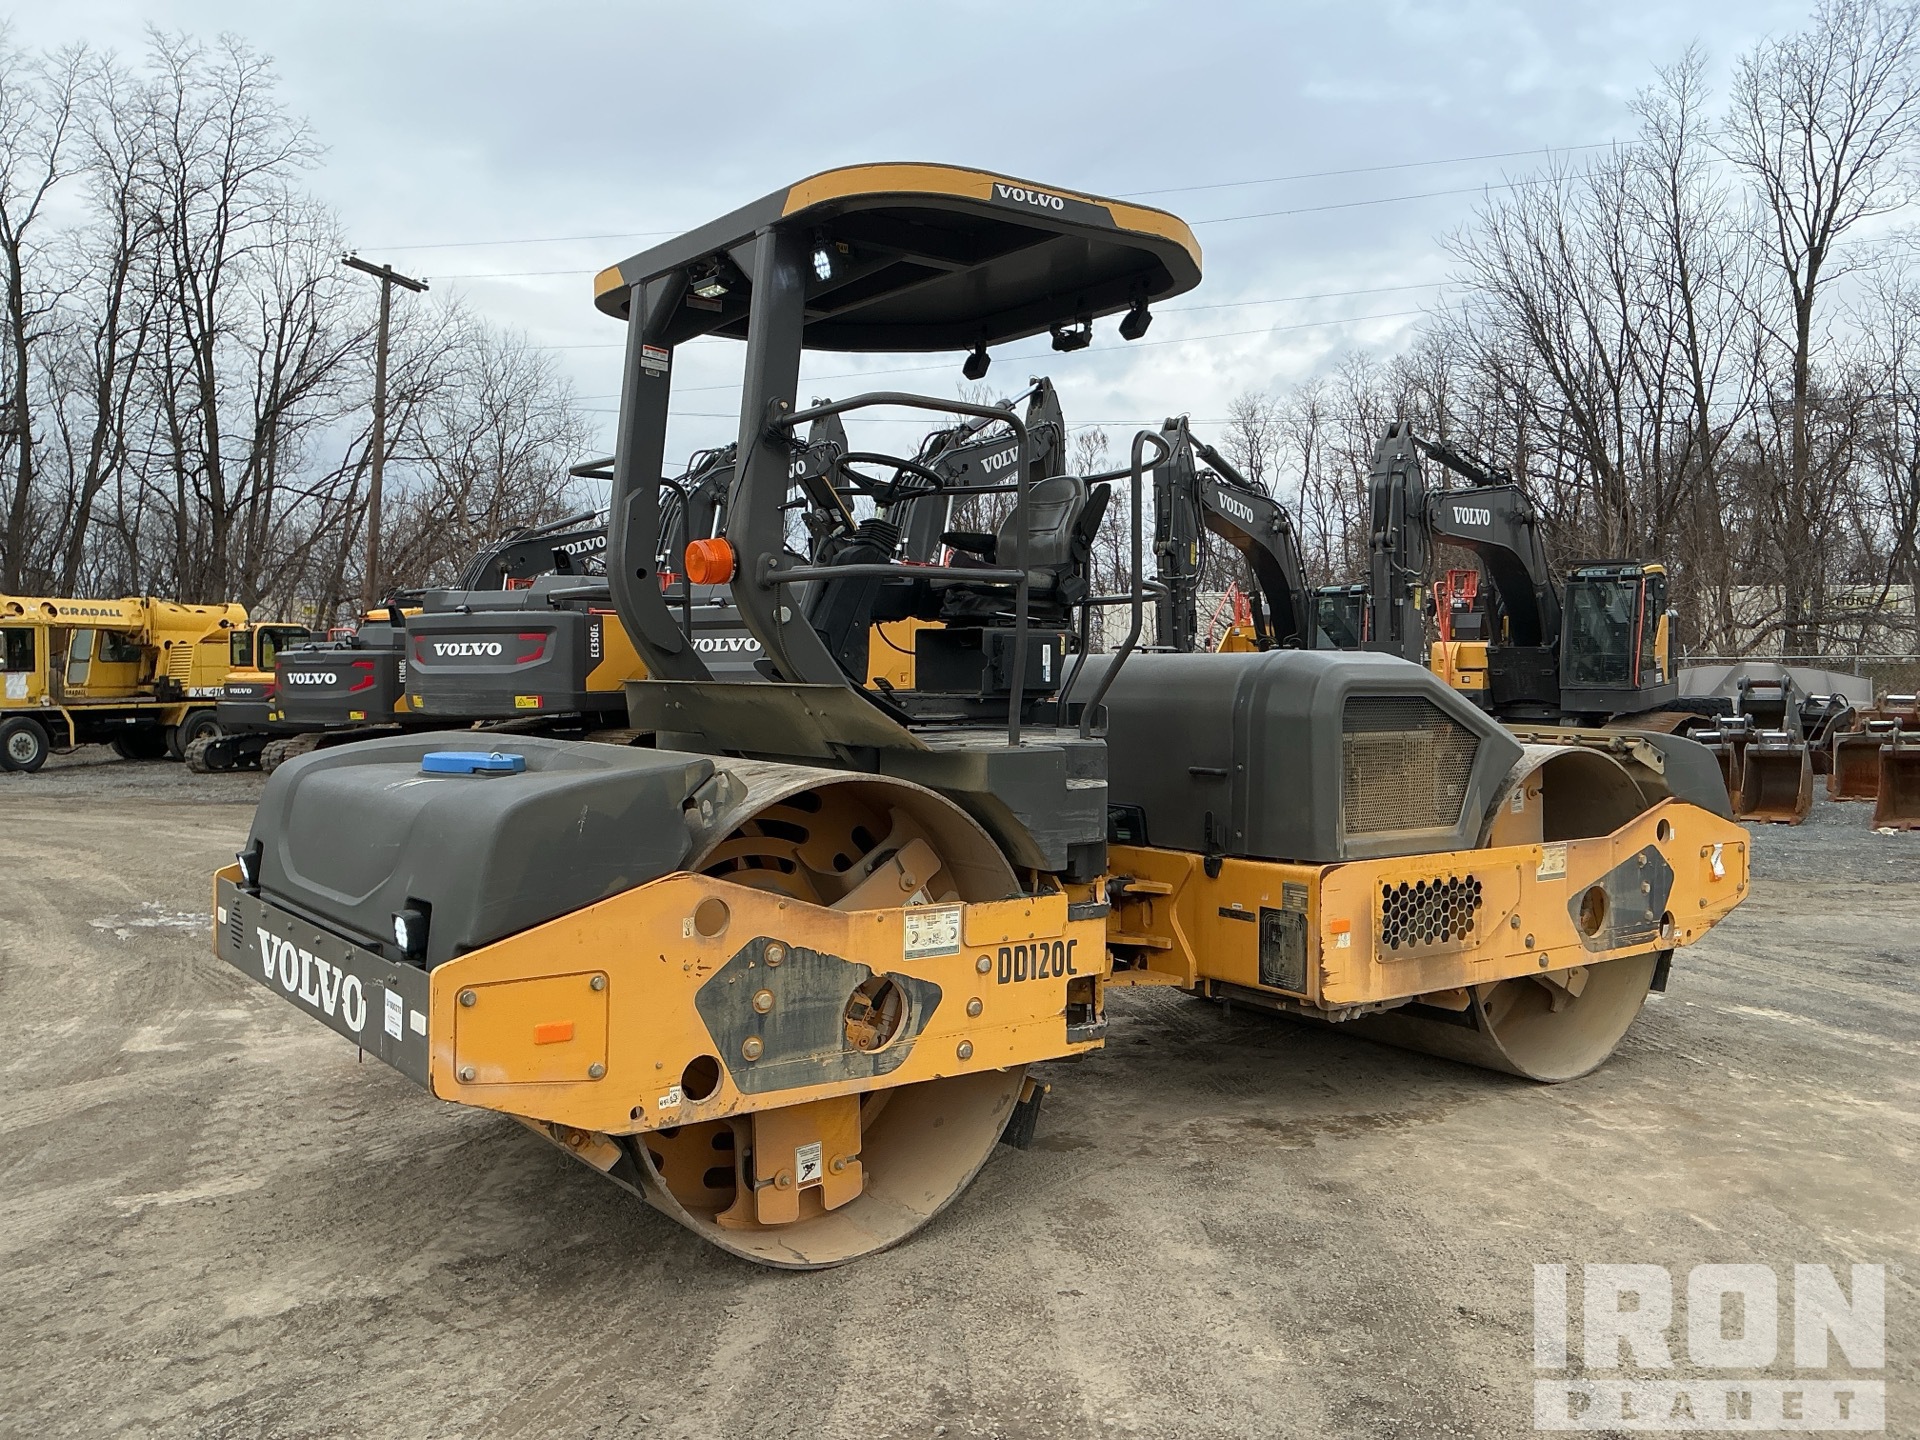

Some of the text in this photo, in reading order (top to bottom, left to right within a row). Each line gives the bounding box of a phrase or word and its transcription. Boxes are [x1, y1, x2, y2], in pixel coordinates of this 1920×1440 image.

[995, 184, 1064, 210] VOLVO
[981, 446, 1019, 473] VOLV
[1217, 490, 1254, 523] VOLVO
[1453, 506, 1490, 526] VOLVO
[59, 607, 123, 617] GRADALL
[433, 642, 502, 656] VOLVO
[287, 672, 337, 685] VOLVO
[194, 688, 207, 697] XL
[998, 939, 1078, 985] DD120C
[257, 926, 366, 1032] VOLVO
